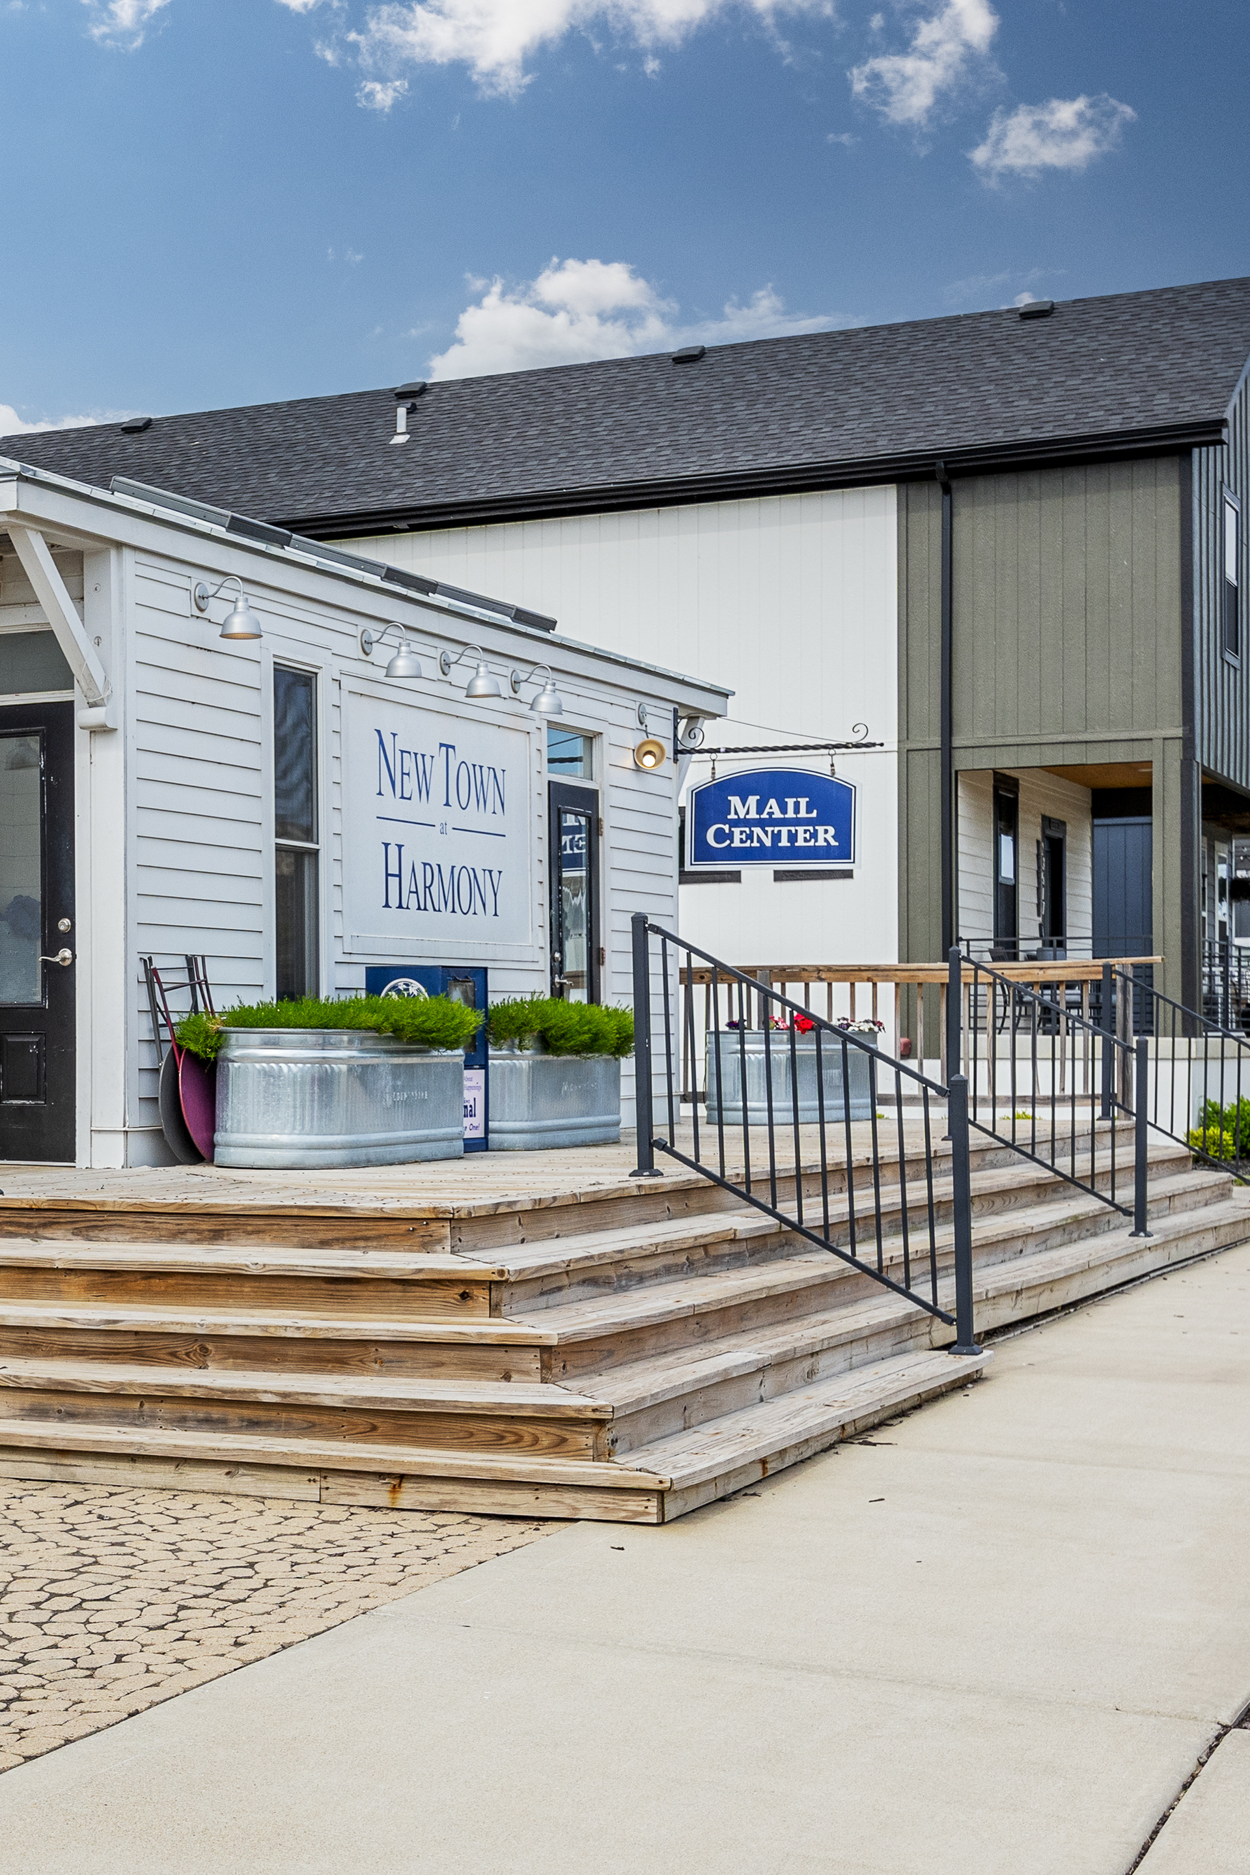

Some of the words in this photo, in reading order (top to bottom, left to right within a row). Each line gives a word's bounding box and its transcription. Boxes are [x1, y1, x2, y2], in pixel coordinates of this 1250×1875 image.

[374, 728, 435, 805] NEW
[438, 742, 507, 817] TOWN
[727, 795, 817, 819] MAIL
[439, 821, 448, 835] at
[706, 823, 839, 848] CENTER
[381, 841, 503, 917] HARMONY
